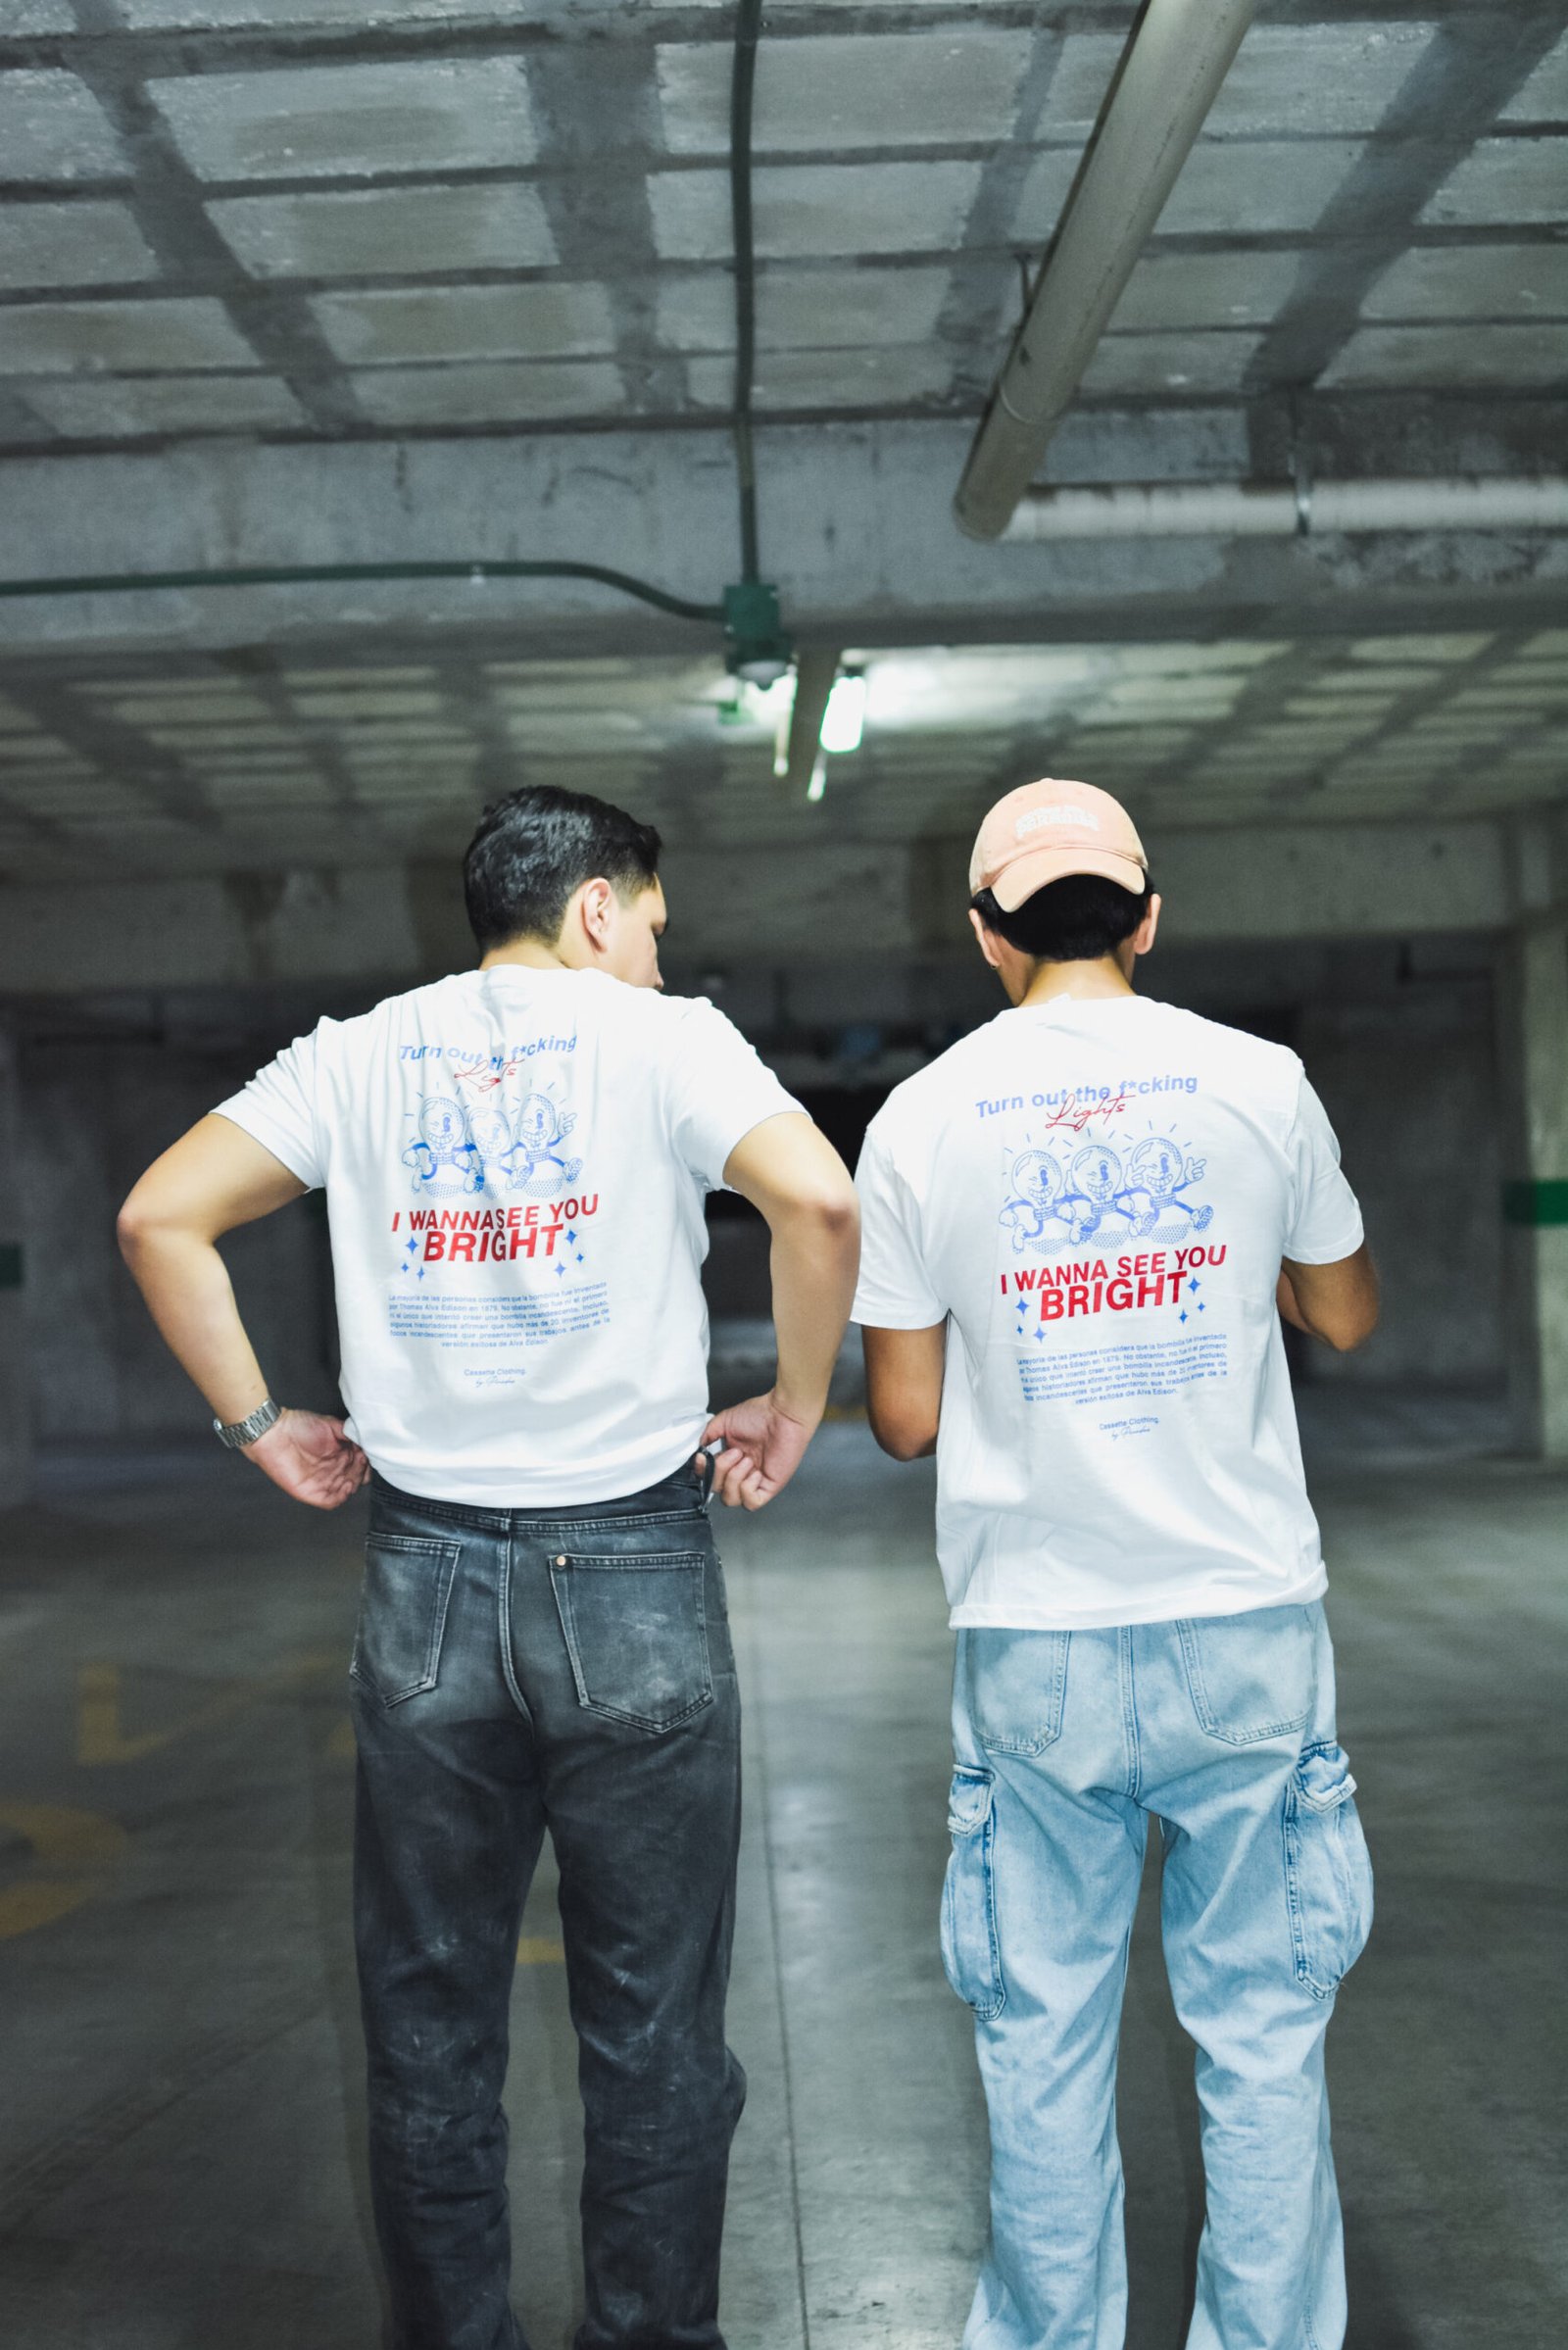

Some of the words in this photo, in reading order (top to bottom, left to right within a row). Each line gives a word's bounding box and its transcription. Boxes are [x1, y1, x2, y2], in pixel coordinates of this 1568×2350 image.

[400, 1045, 442, 1060] Turn
[447, 1047, 483, 1066] out
[975, 1097, 1024, 1118] Turn
[1032, 1088, 1067, 1106] out
[1075, 1086, 1110, 1102] the
[391, 1211, 401, 1233] I
[409, 1208, 494, 1231] WANNA
[495, 1205, 540, 1230] SEE
[549, 1193, 599, 1223] YOU
[423, 1223, 564, 1263] BRIGHT
[1000, 1273, 1007, 1295] I
[1014, 1258, 1108, 1293] WANNA
[1117, 1251, 1166, 1278] SEE
[1174, 1244, 1227, 1270] YOU
[1040, 1270, 1188, 1322] BRIGHT
